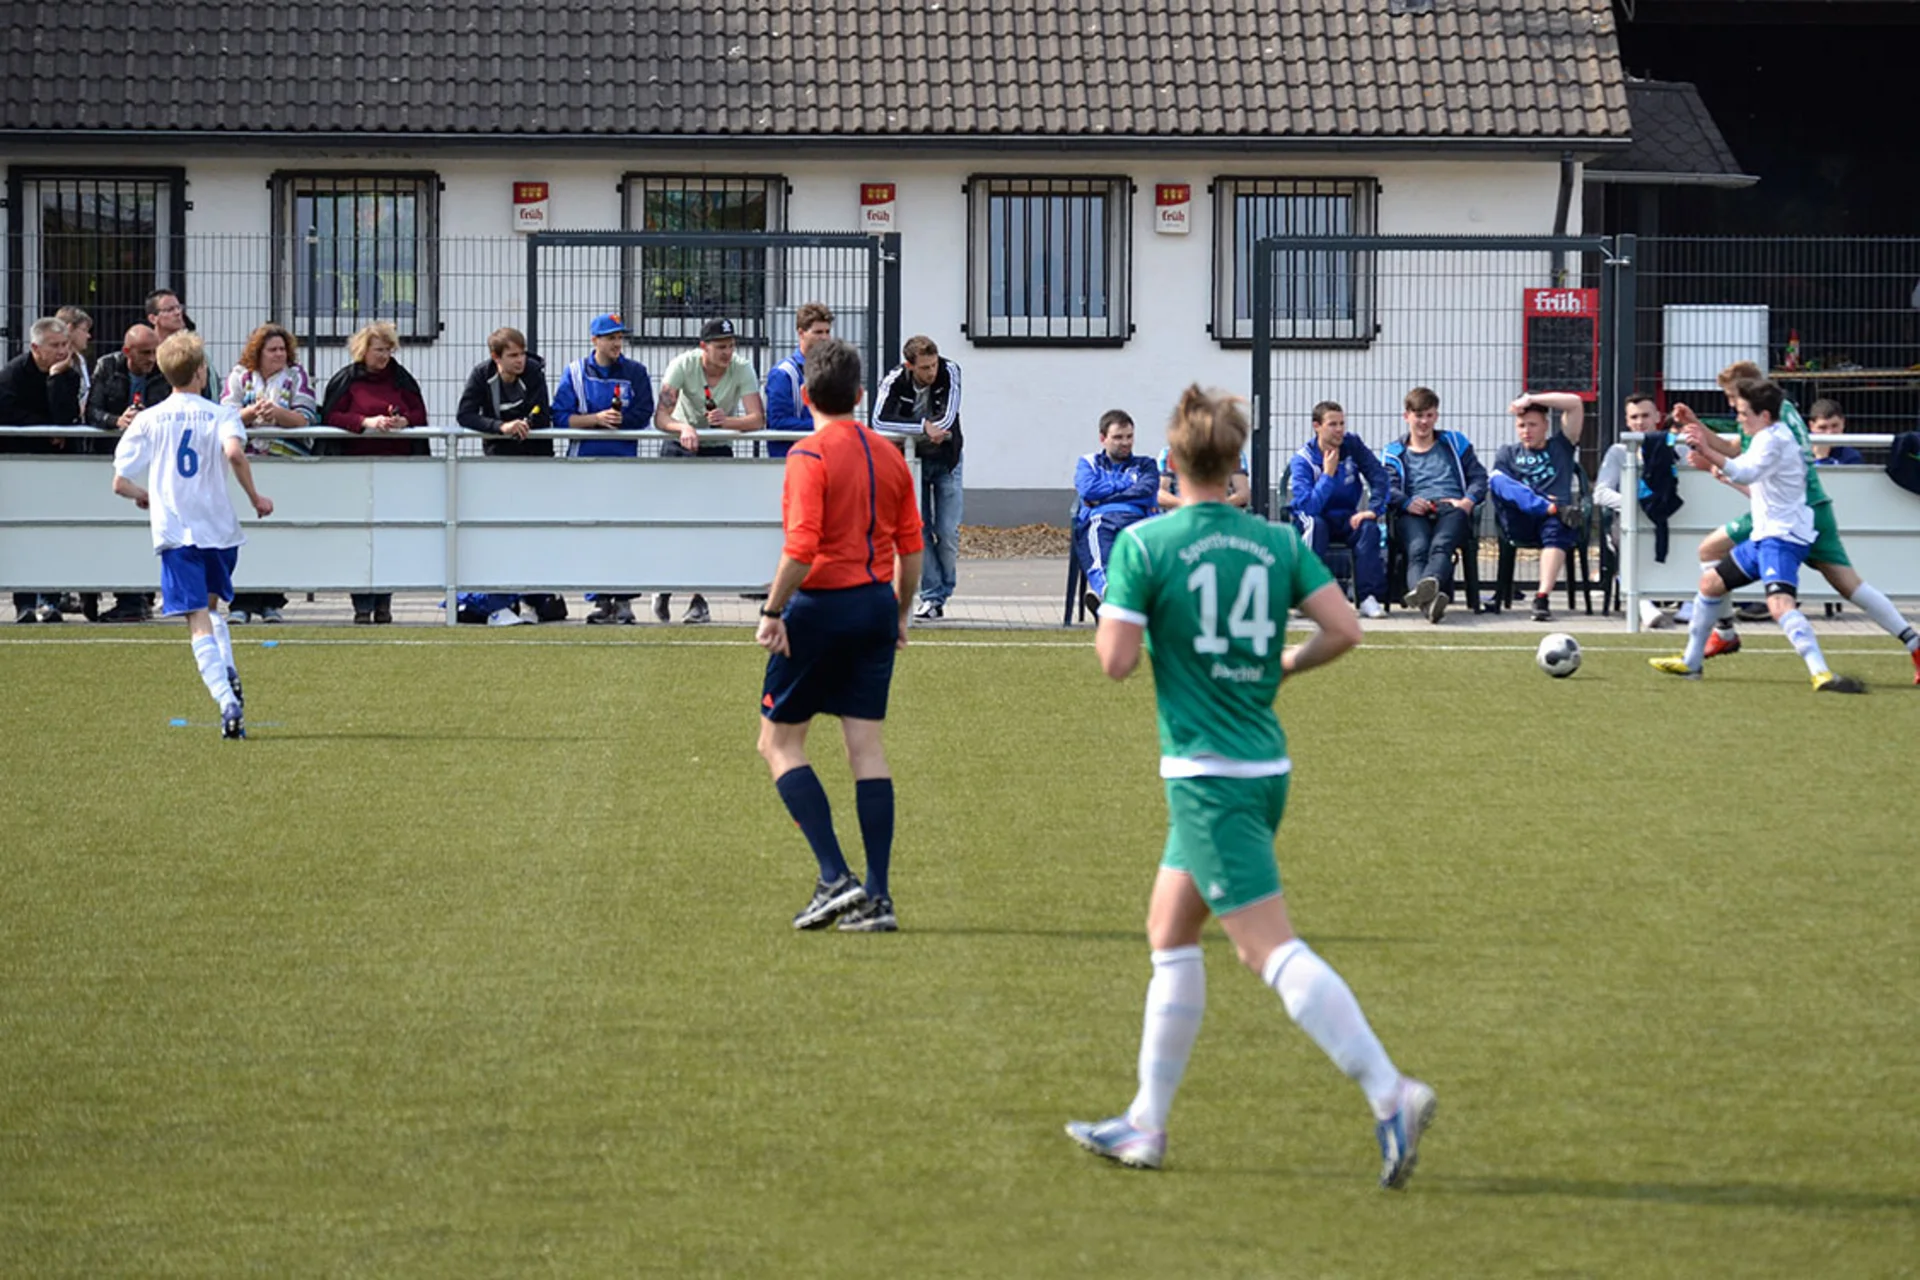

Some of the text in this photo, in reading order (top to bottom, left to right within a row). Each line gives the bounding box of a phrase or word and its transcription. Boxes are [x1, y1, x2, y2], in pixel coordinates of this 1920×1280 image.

[1533, 291, 1581, 314] früh
[177, 429, 198, 478] 6
[1187, 562, 1276, 656] 14
